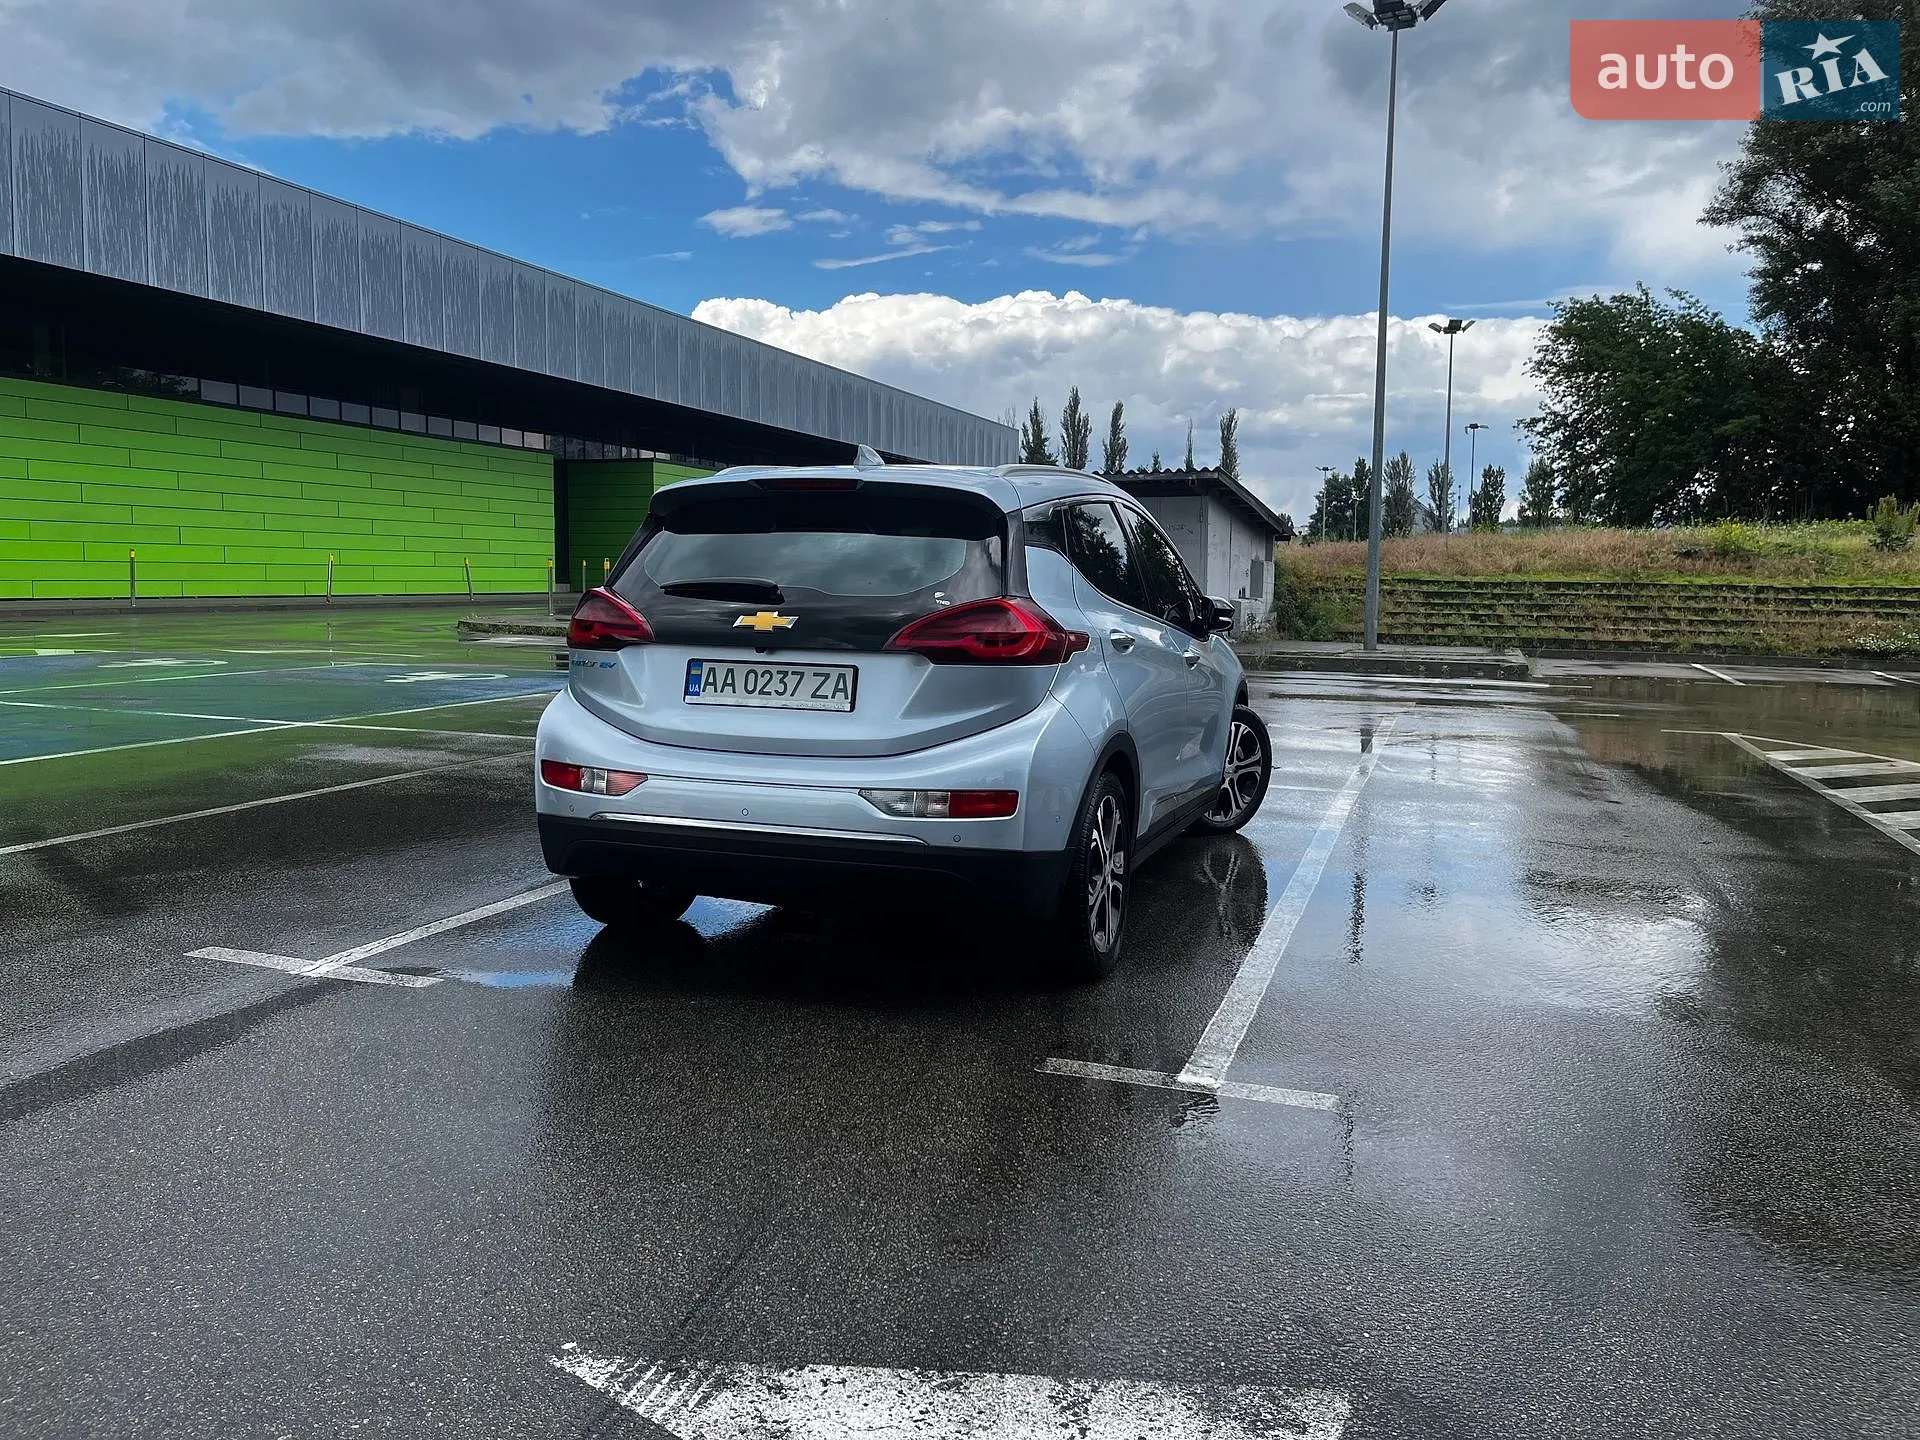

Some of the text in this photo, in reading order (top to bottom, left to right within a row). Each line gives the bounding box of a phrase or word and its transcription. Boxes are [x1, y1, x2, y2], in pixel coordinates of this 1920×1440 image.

[688, 683, 700, 693] UA
[701, 667, 850, 700] AA 0237 ZA
